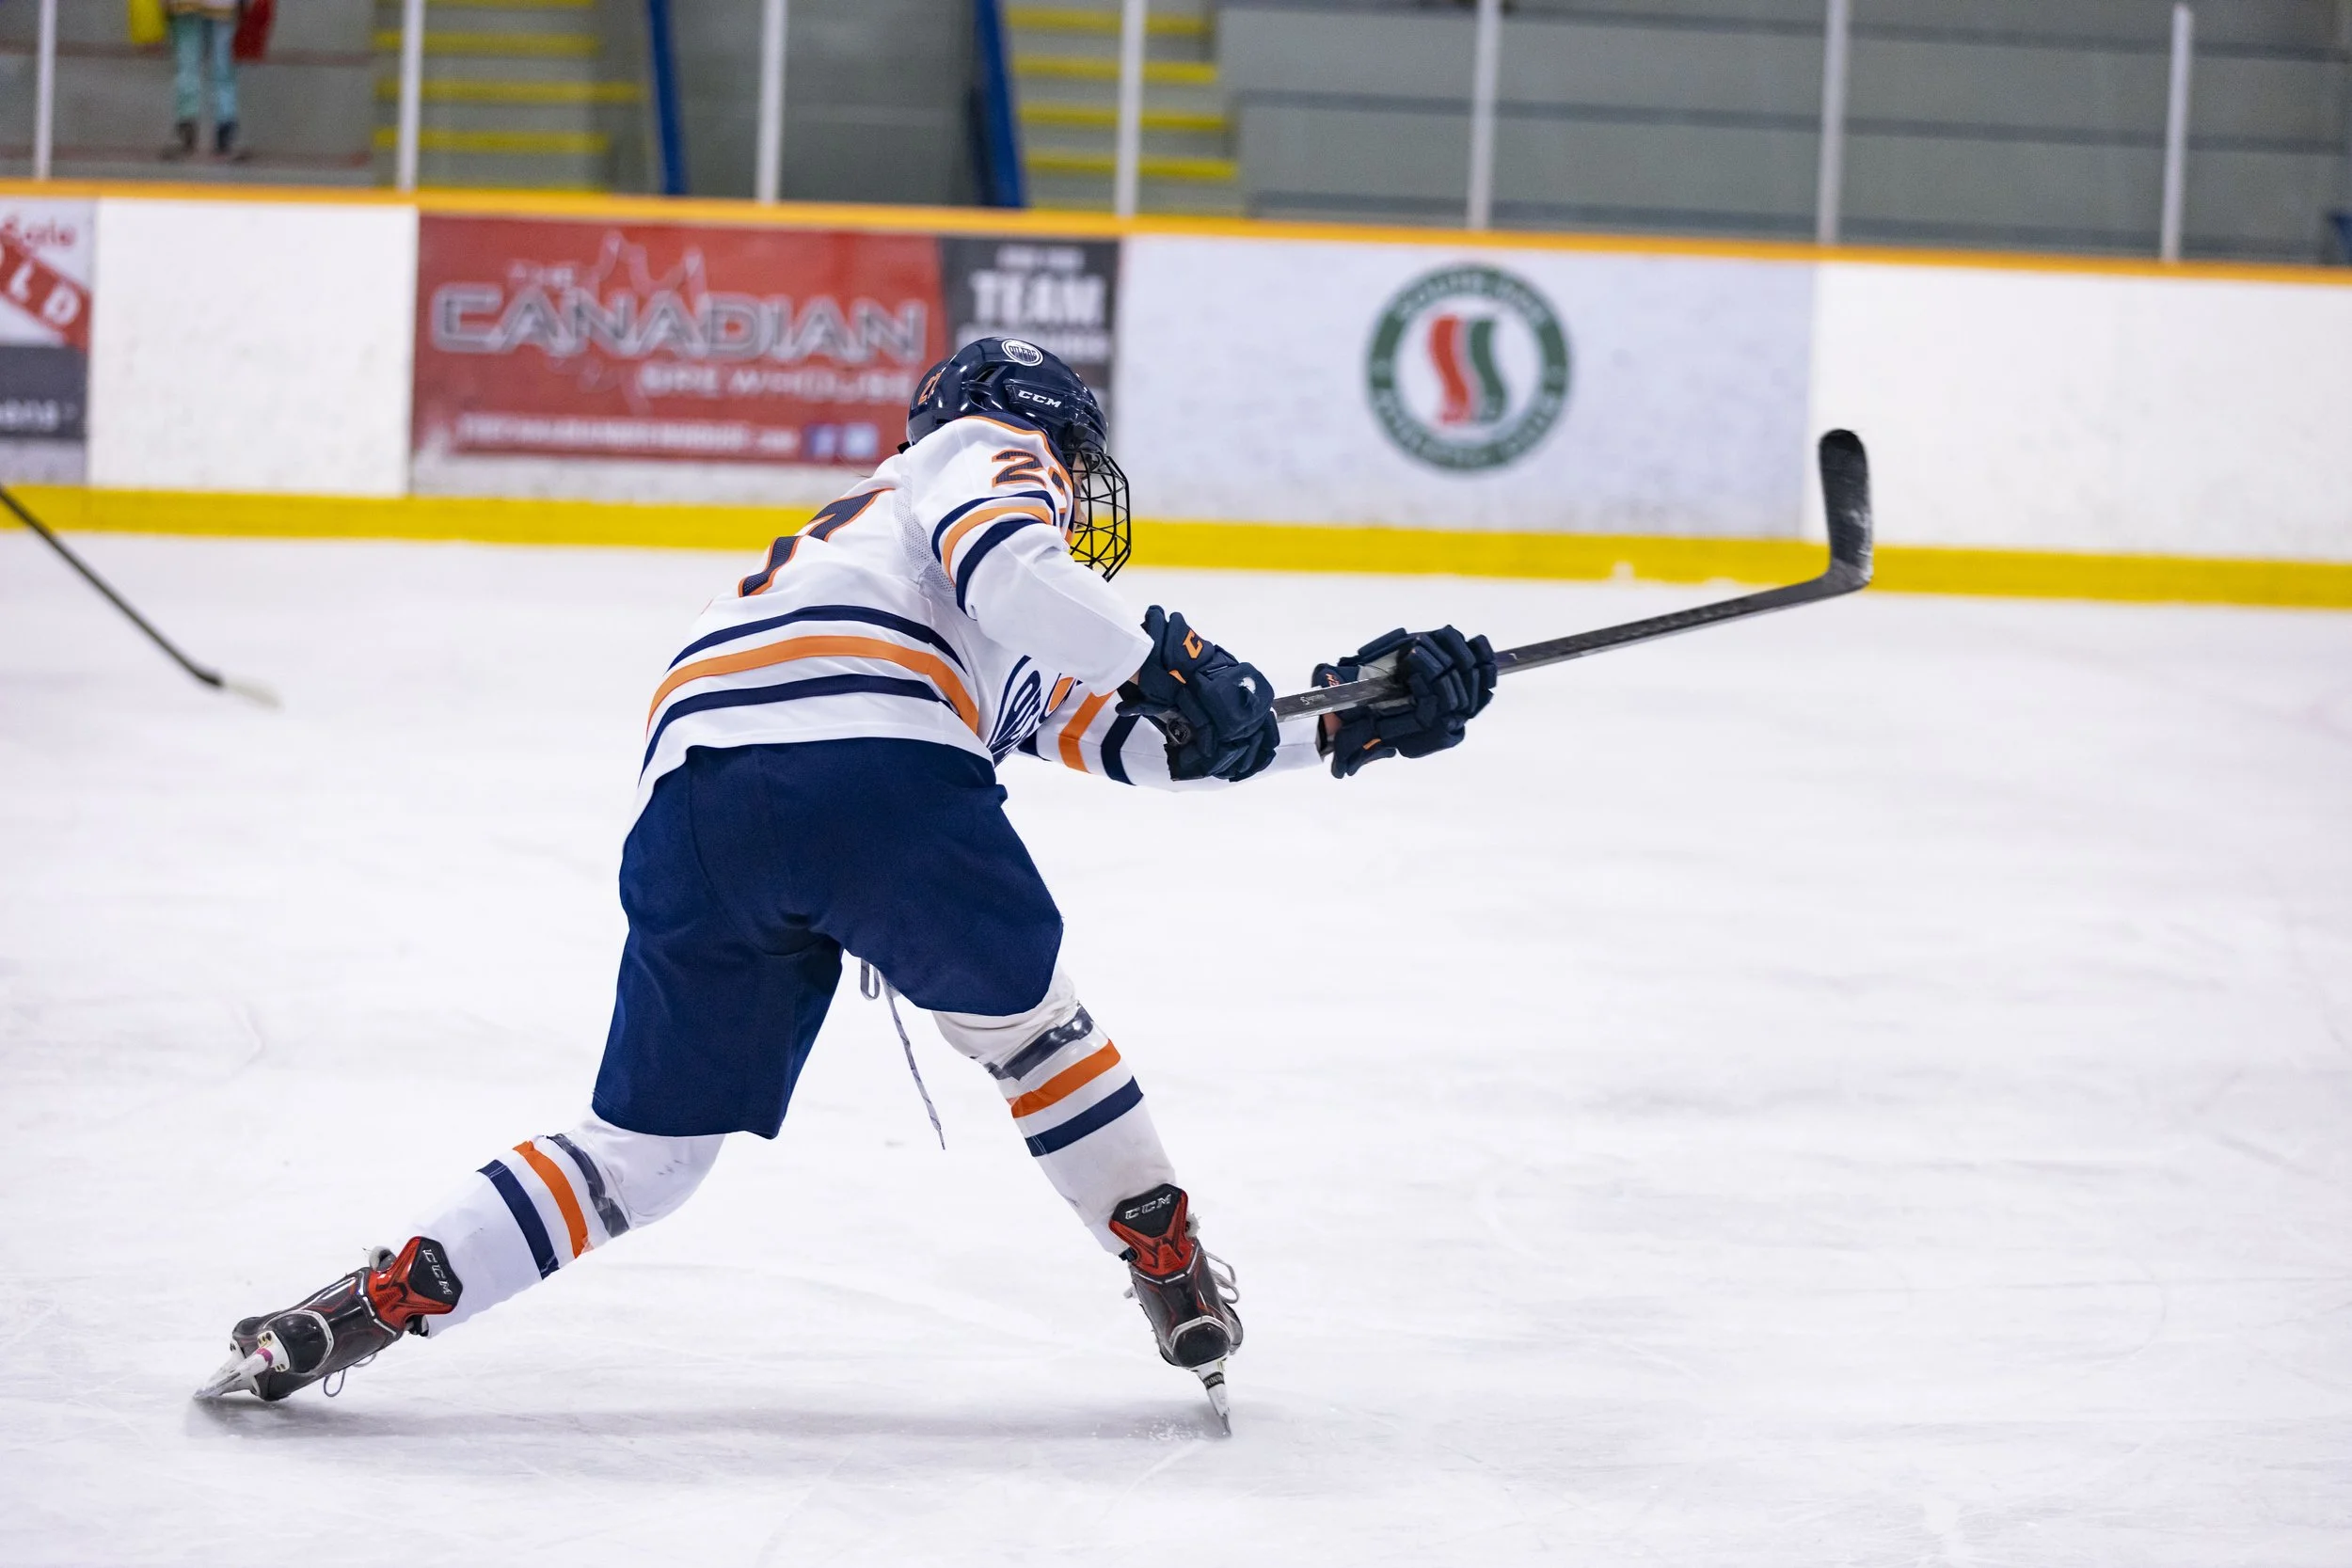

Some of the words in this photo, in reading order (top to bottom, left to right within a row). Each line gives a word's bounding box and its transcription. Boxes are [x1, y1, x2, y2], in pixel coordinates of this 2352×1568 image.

[0, 243, 83, 325] LD
[971, 270, 1106, 325] TEAM
[430, 285, 928, 363] CANADIAN
[1017, 389, 1062, 409] CCM
[1124, 1194, 1171, 1221] CCM
[422, 1248, 454, 1296] CCM
